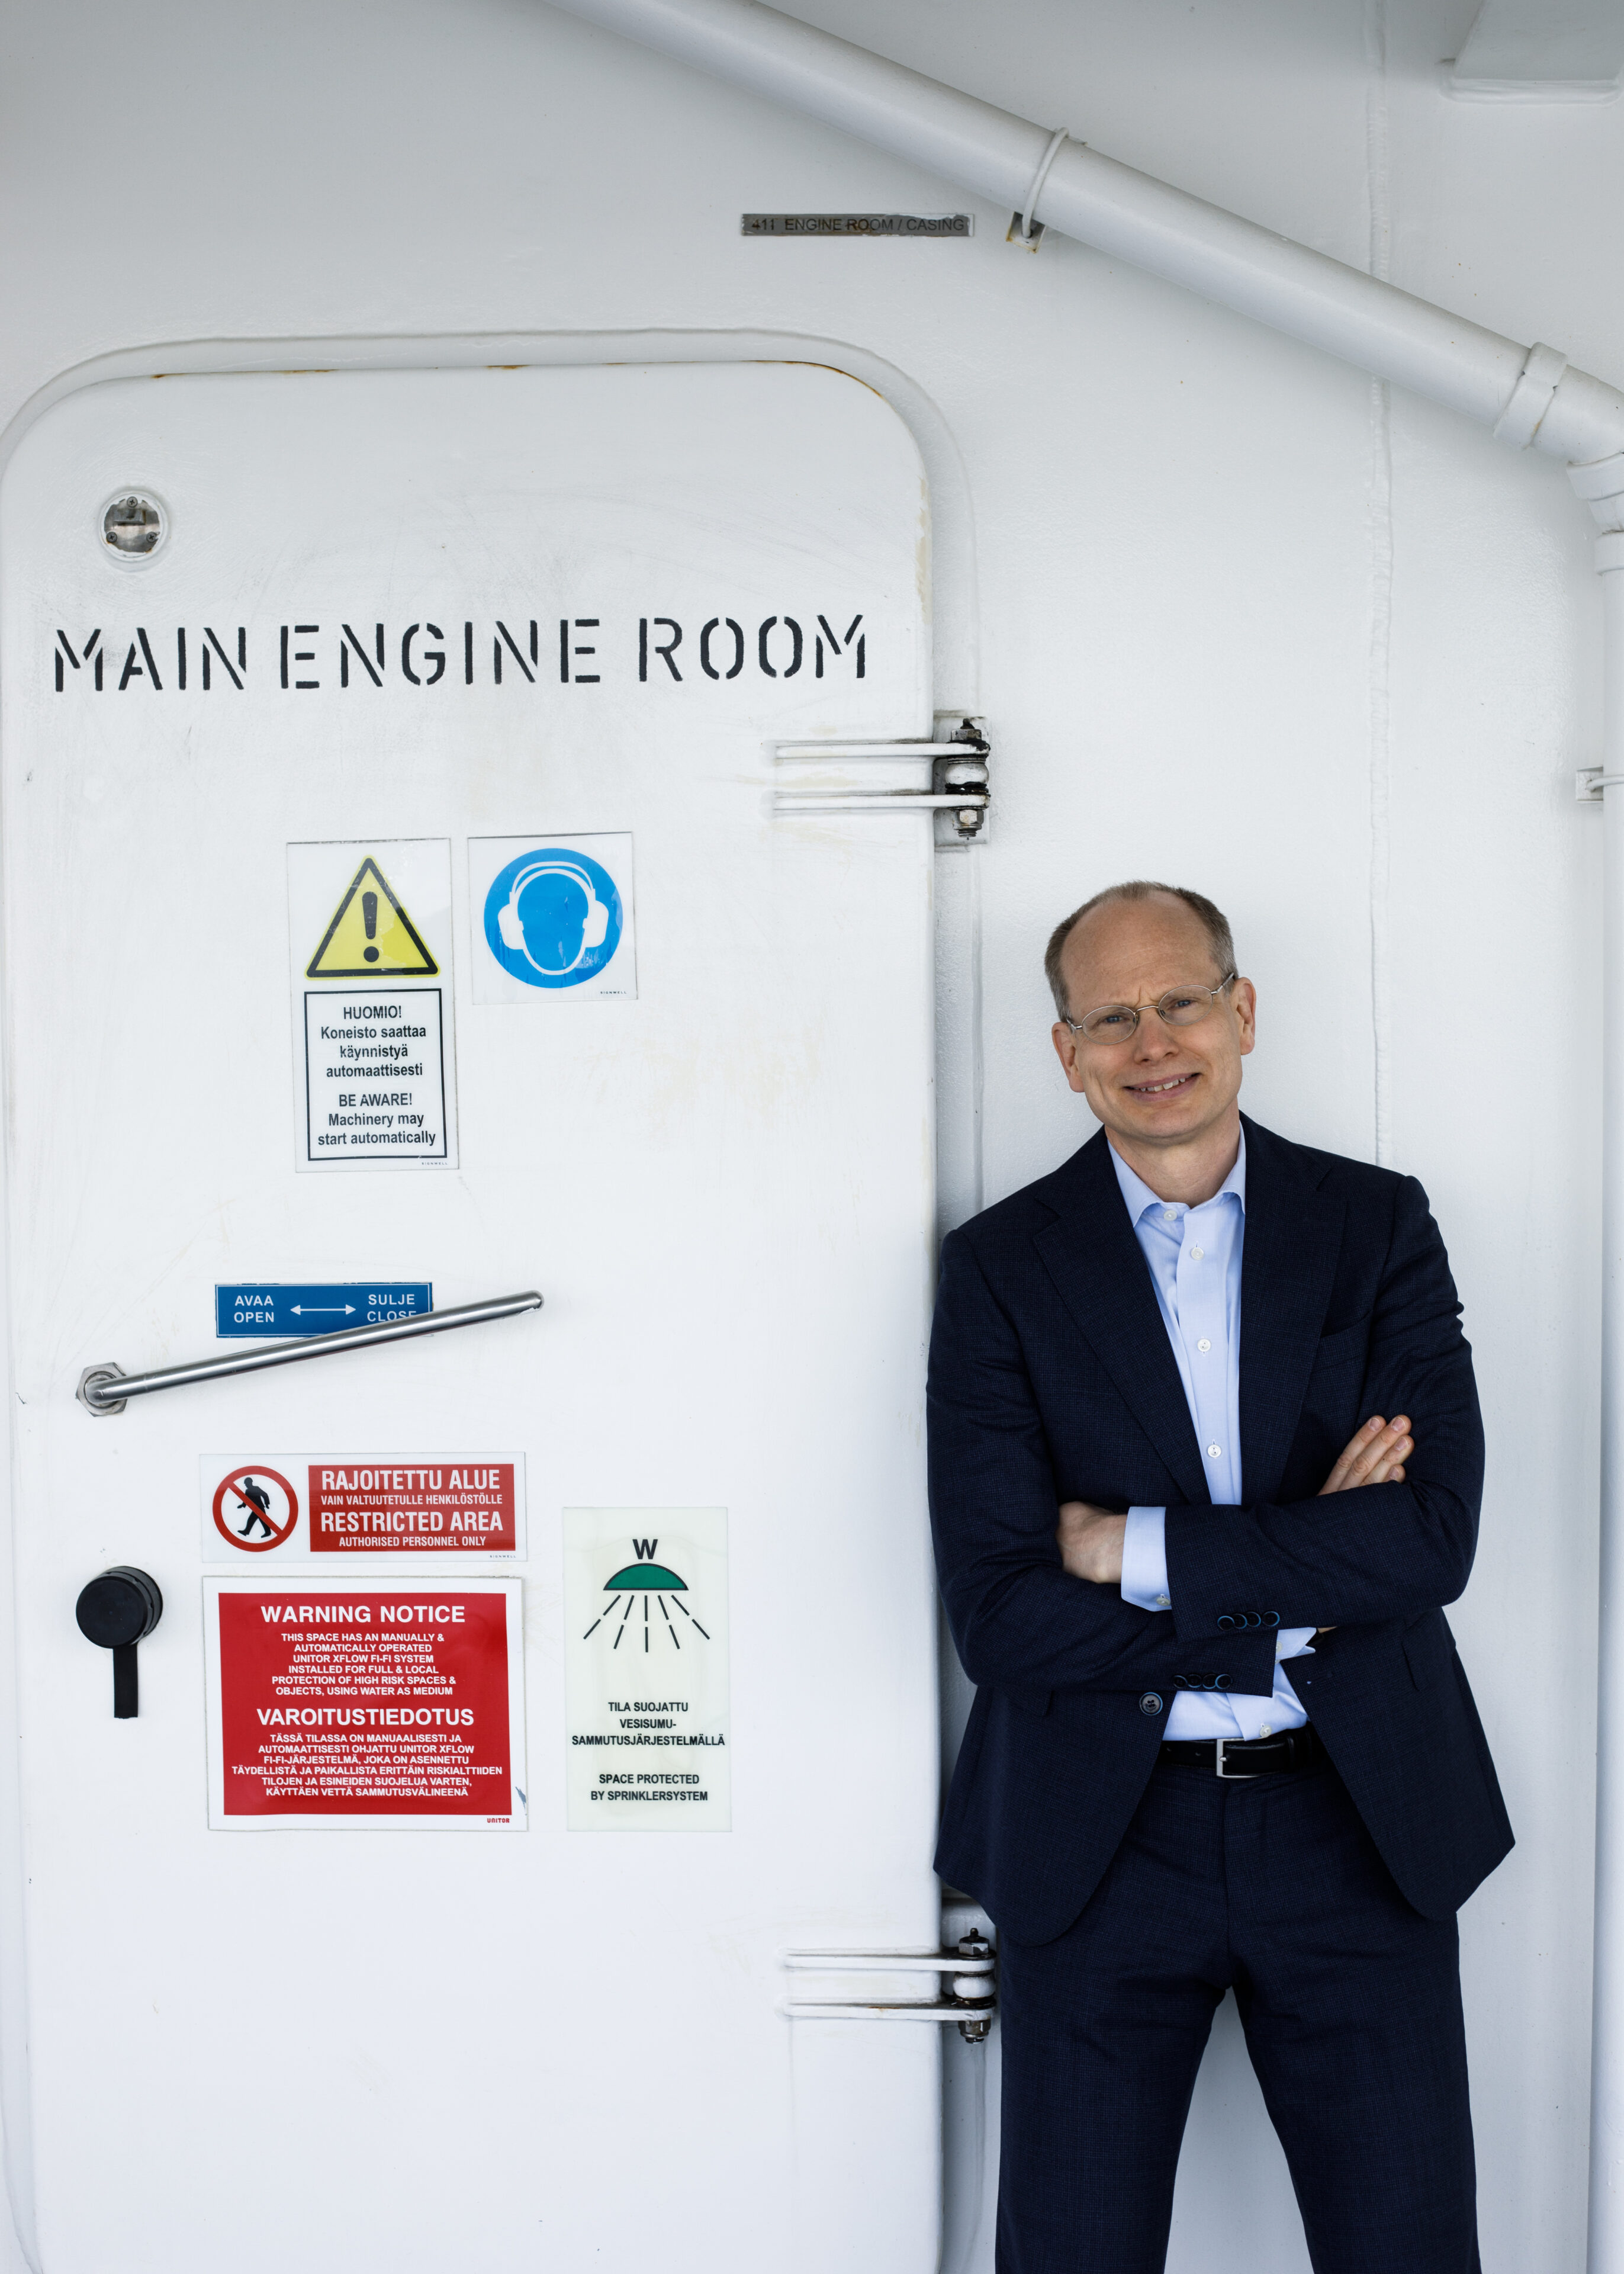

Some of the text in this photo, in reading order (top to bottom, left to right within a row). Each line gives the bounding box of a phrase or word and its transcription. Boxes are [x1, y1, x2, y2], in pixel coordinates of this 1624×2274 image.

[752, 219, 964, 231] 411 ENGINE ROOM / CASING
[55, 615, 865, 692] MAIN ENGINE ROOM
[344, 1006, 401, 1019] HUOMIO!
[321, 1026, 426, 1039] Koneisto saattaa
[340, 1044, 407, 1061] käynnistyä
[327, 1063, 422, 1077] automaattisesti
[339, 1093, 411, 1106] BE AWARE!
[329, 1113, 423, 1128] Machinery may
[319, 1130, 435, 1146] start automatically
[235, 1296, 274, 1306] AVAA
[369, 1295, 414, 1305] SULJE
[234, 1312, 274, 1322] OPEN
[322, 1470, 500, 1490] RAJOITETTU ALUE
[321, 1493, 502, 1505] VAIN VALTUUTETULLE HENKILÖSTÖLLE
[321, 1511, 503, 1531] RESTRICTED AREA
[339, 1536, 485, 1546] AUTHORISED PERSONNEL ONLY
[633, 1539, 658, 1559] W
[261, 1606, 465, 1623] WARNING NOTICE
[276, 1687, 324, 1695] OBJECTS,
[609, 1702, 688, 1711] TILA SUOJATTU
[257, 1708, 474, 1725] VAROITUSTIEDOTUS
[620, 1719, 676, 1728] VESISUMU-
[270, 1733, 303, 1742] TÄSSÄ
[573, 1734, 725, 1745] SAMMUTUSJÄRJESTELMÄLLÄ
[264, 1754, 361, 1765] FI-FI-JÄRJESTELMÄ,
[232, 1765, 297, 1774] TÄYDELLISTÄ
[380, 1765, 424, 1774] ERITTÄIN
[262, 1777, 303, 1785] TILOJEN
[320, 1777, 372, 1785] ESINEIDEN
[375, 1777, 427, 1785] SUOJELUA
[430, 1778, 471, 1787] VARTEN,
[600, 1774, 699, 1784] SPACE PROTECTED
[266, 1787, 468, 1796] KÄYTTÄEN VETTÄ SAMMUTUSVÄLINEENÄ
[591, 1791, 708, 1800] BY SPRINKLERSYSTEM
